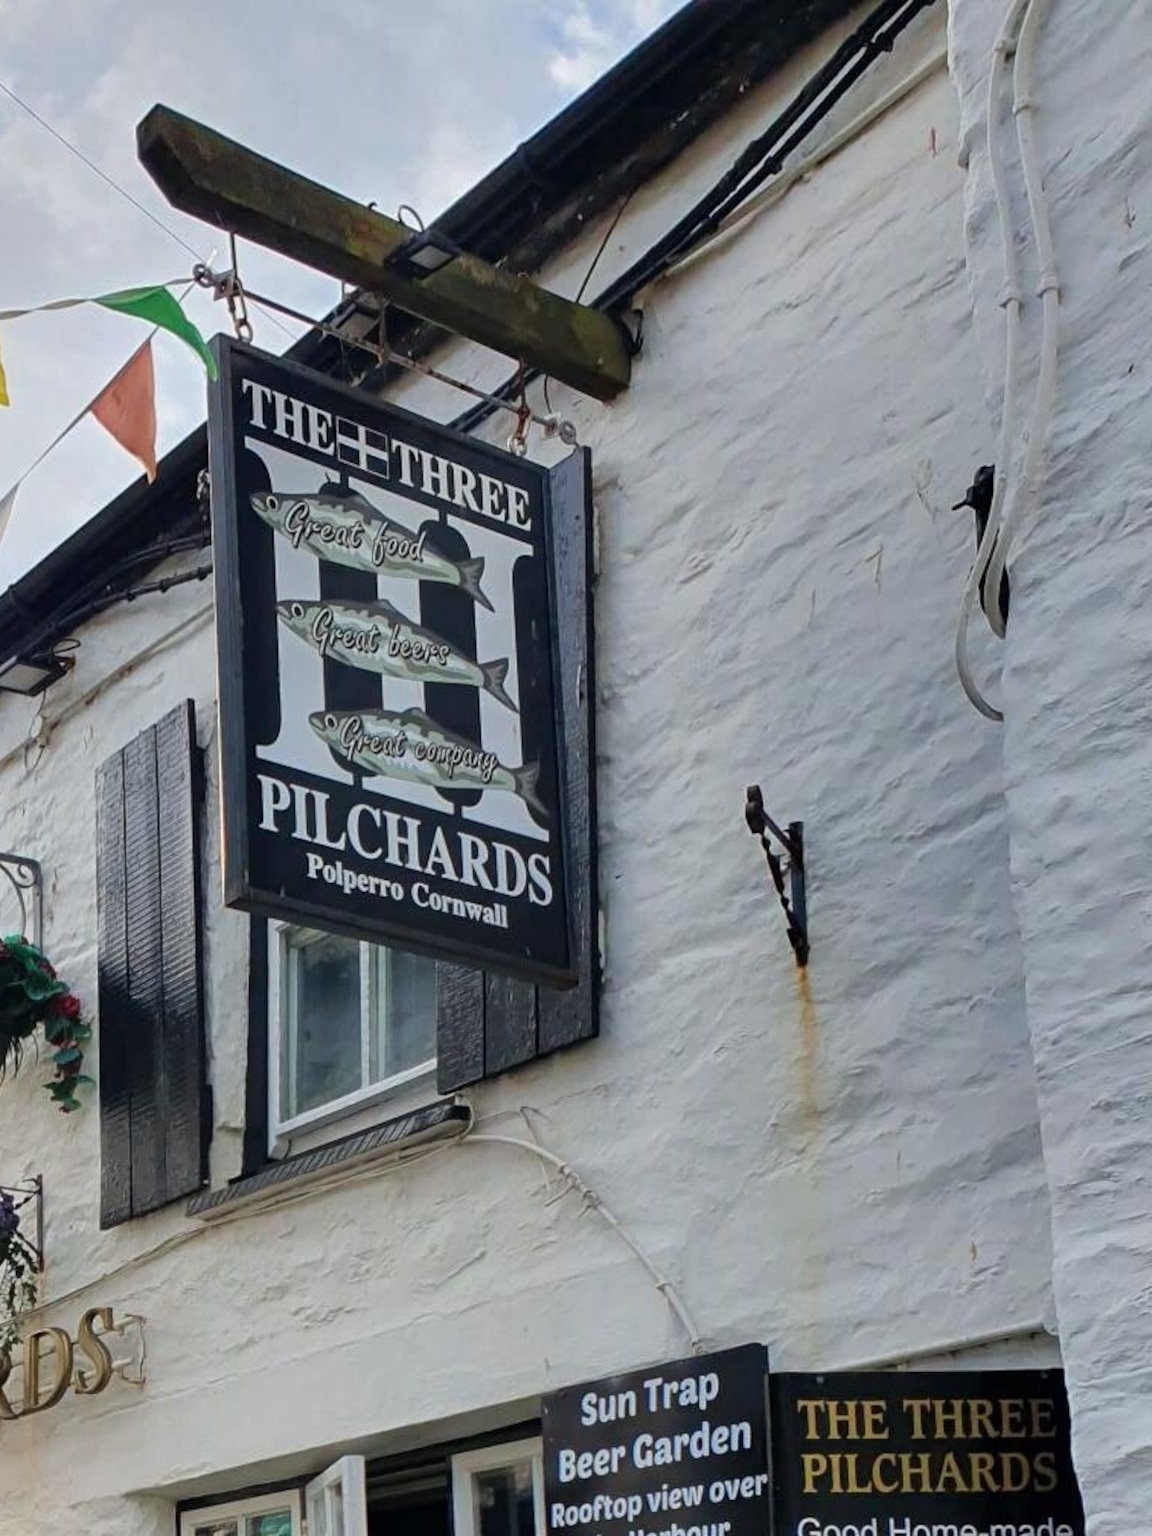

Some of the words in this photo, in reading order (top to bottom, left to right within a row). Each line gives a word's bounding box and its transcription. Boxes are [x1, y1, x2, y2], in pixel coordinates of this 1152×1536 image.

[242, 378, 335, 456] THE
[391, 443, 532, 532] THREE
[284, 503, 362, 549] Great
[371, 524, 425, 564] food
[311, 609, 379, 655] Great
[387, 624, 450, 666] beers
[339, 716, 406, 760] Great
[414, 740, 498, 783] company
[257, 774, 553, 907] PILCHARDS
[306, 853, 404, 901] Polperro
[411, 881, 508, 929] Cornwall
[581, 1389, 636, 1426] Sun
[643, 1372, 719, 1412] Trap
[798, 1399, 889, 1440] THE
[903, 1399, 1056, 1440] THREE
[559, 1444, 625, 1482] Beer
[633, 1420, 751, 1469] Garden
[801, 1451, 1058, 1494] PILCHARDS
[551, 1494, 642, 1529] Rooftop
[647, 1483, 704, 1512] view
[709, 1473, 768, 1504] over
